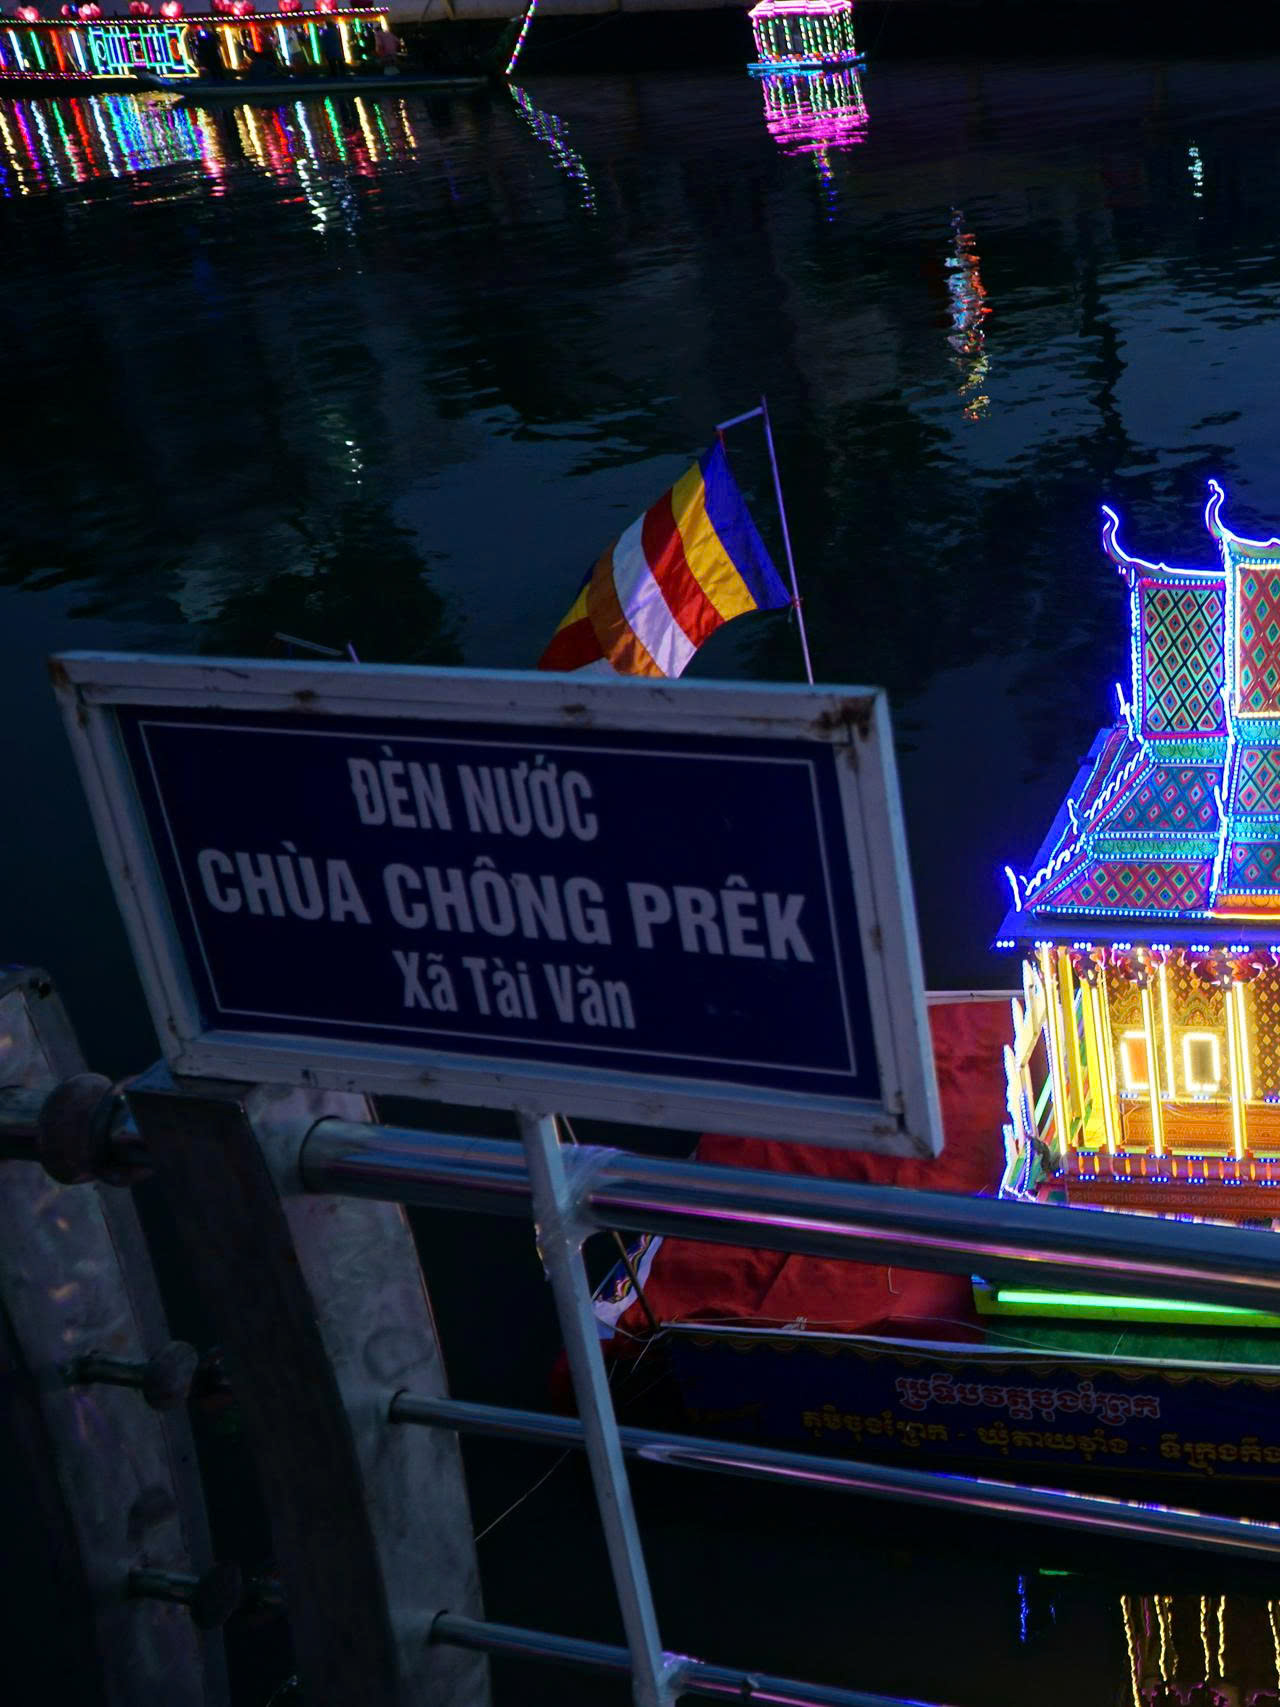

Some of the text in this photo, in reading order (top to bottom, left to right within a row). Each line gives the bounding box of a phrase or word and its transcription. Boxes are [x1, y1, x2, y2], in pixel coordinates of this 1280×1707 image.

[347, 744, 599, 841] ĐÈN NƯỚC
[198, 840, 814, 964] CHÙA CHÔNG PRÊK
[392, 948, 637, 1030] Xã Tài Văn
